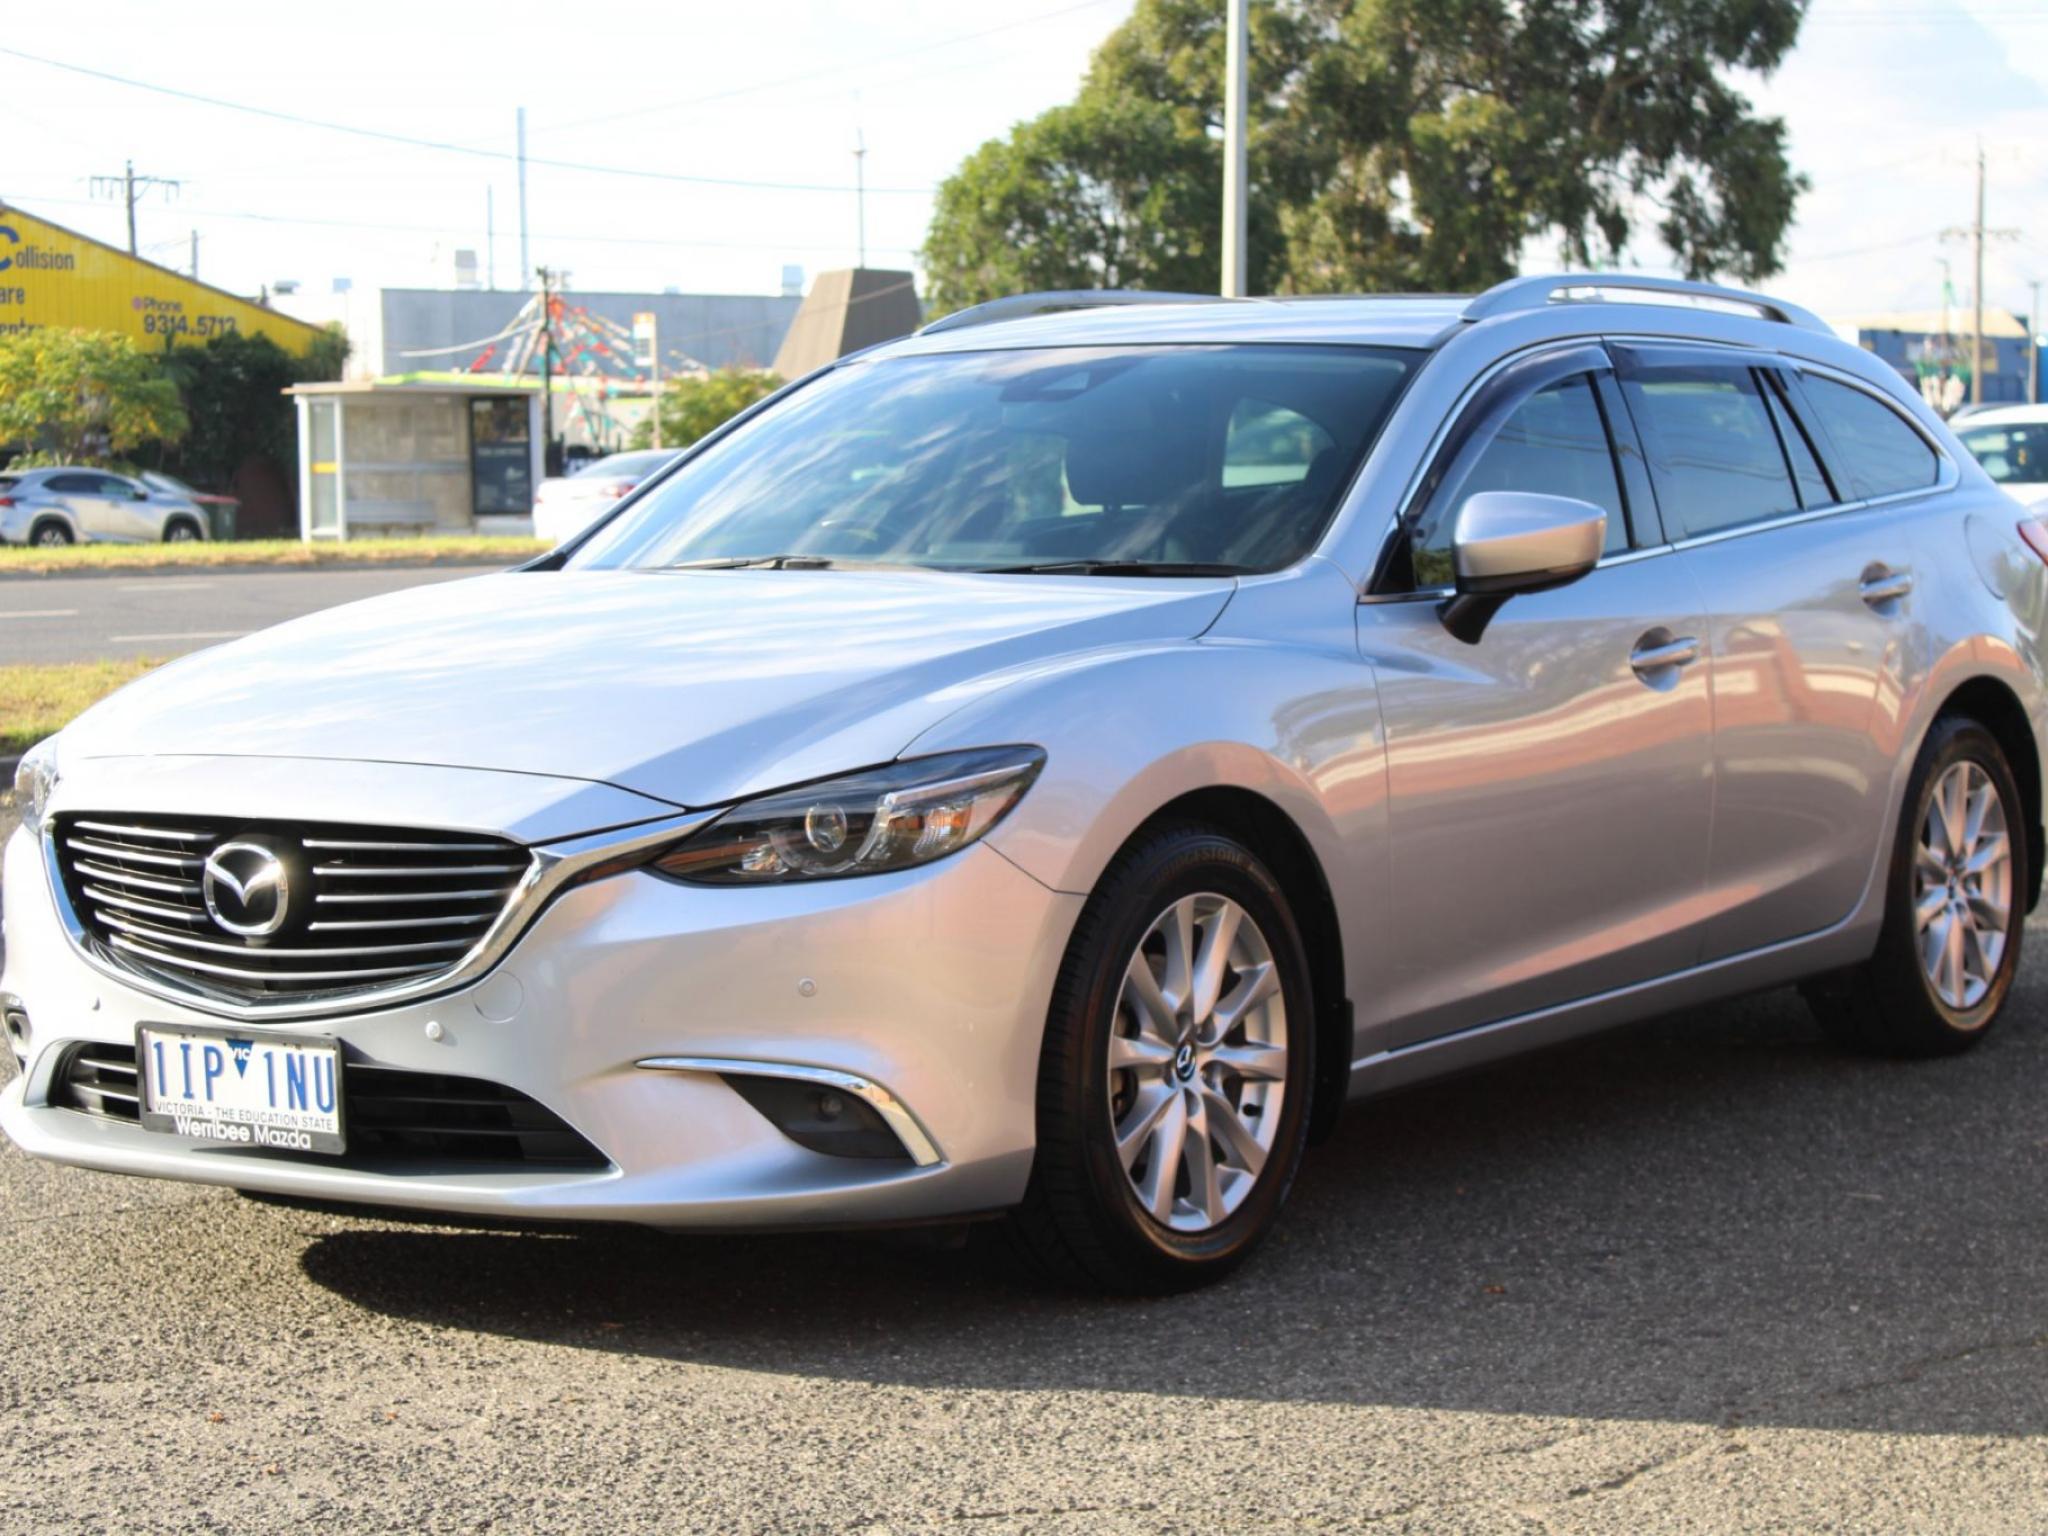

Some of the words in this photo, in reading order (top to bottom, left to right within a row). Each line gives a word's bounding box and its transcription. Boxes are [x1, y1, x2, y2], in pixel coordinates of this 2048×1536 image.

[144, 296, 182, 312] Phone
[153, 1041, 225, 1101] 1IP
[263, 1051, 335, 1114] 1NU
[156, 1101, 205, 1116] VICTORIA
[216, 1107, 236, 1121] THE
[239, 1110, 298, 1126] EDUCATION
[302, 1117, 333, 1131] STATE
[173, 1115, 250, 1142] Werribee
[254, 1124, 312, 1149] Mazda
